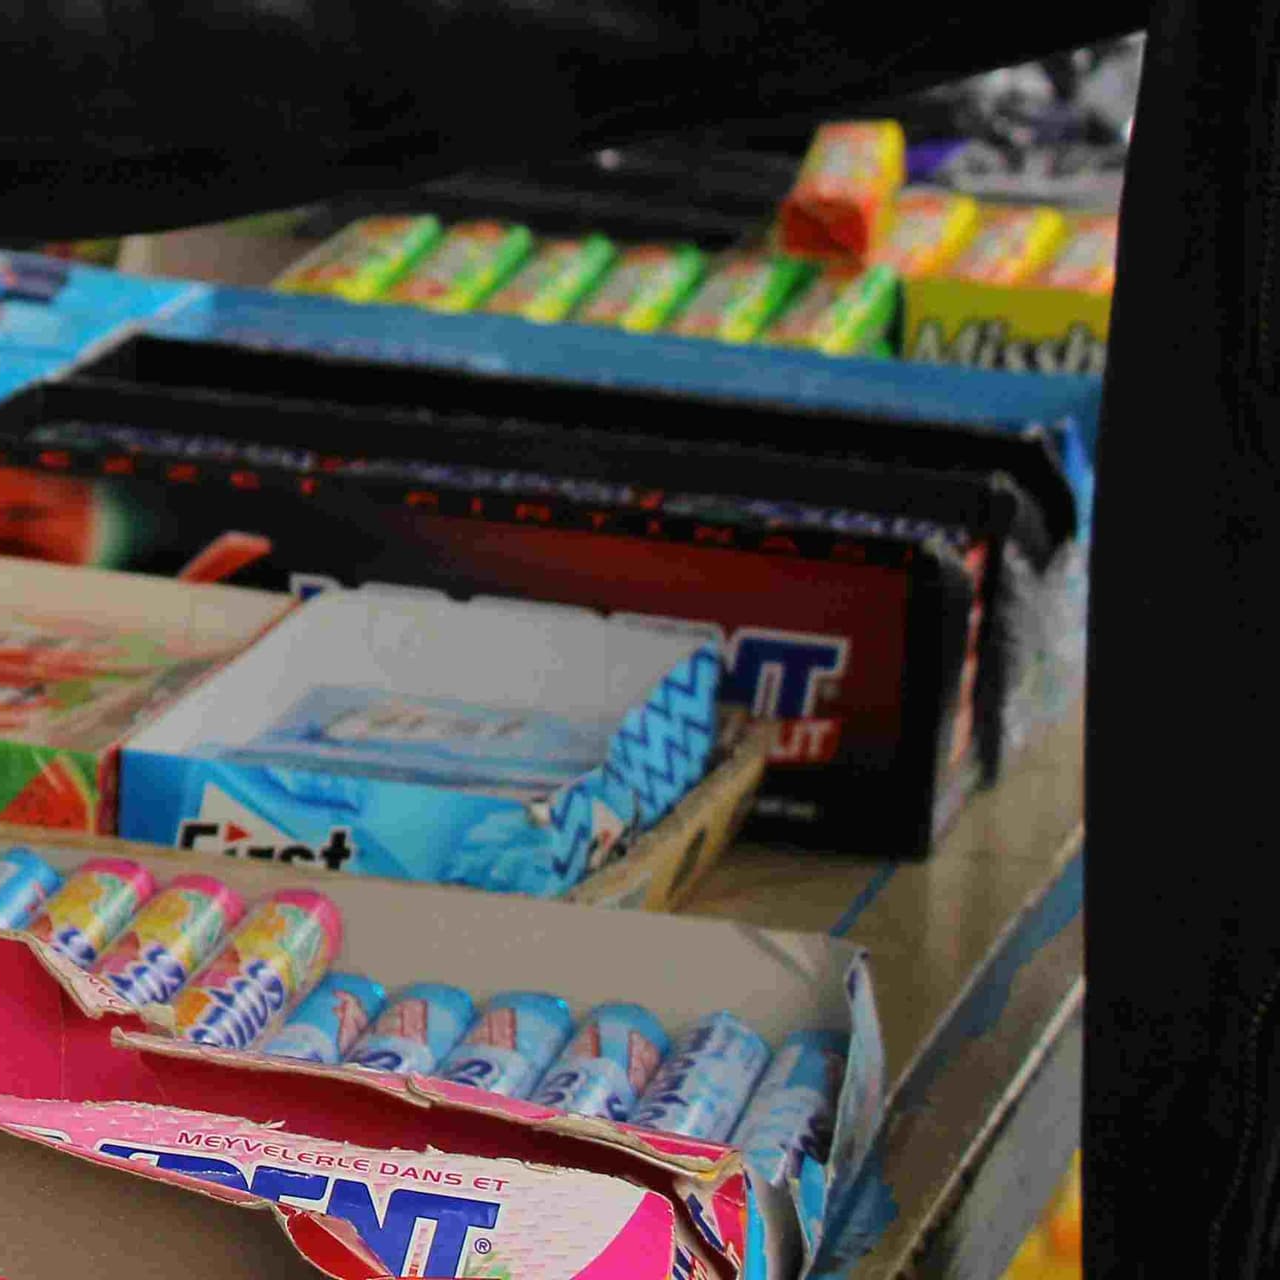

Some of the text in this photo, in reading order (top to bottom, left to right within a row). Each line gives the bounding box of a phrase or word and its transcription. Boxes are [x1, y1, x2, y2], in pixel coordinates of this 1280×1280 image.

[177, 1131, 510, 1192] MEYVELERLE DANS ET
